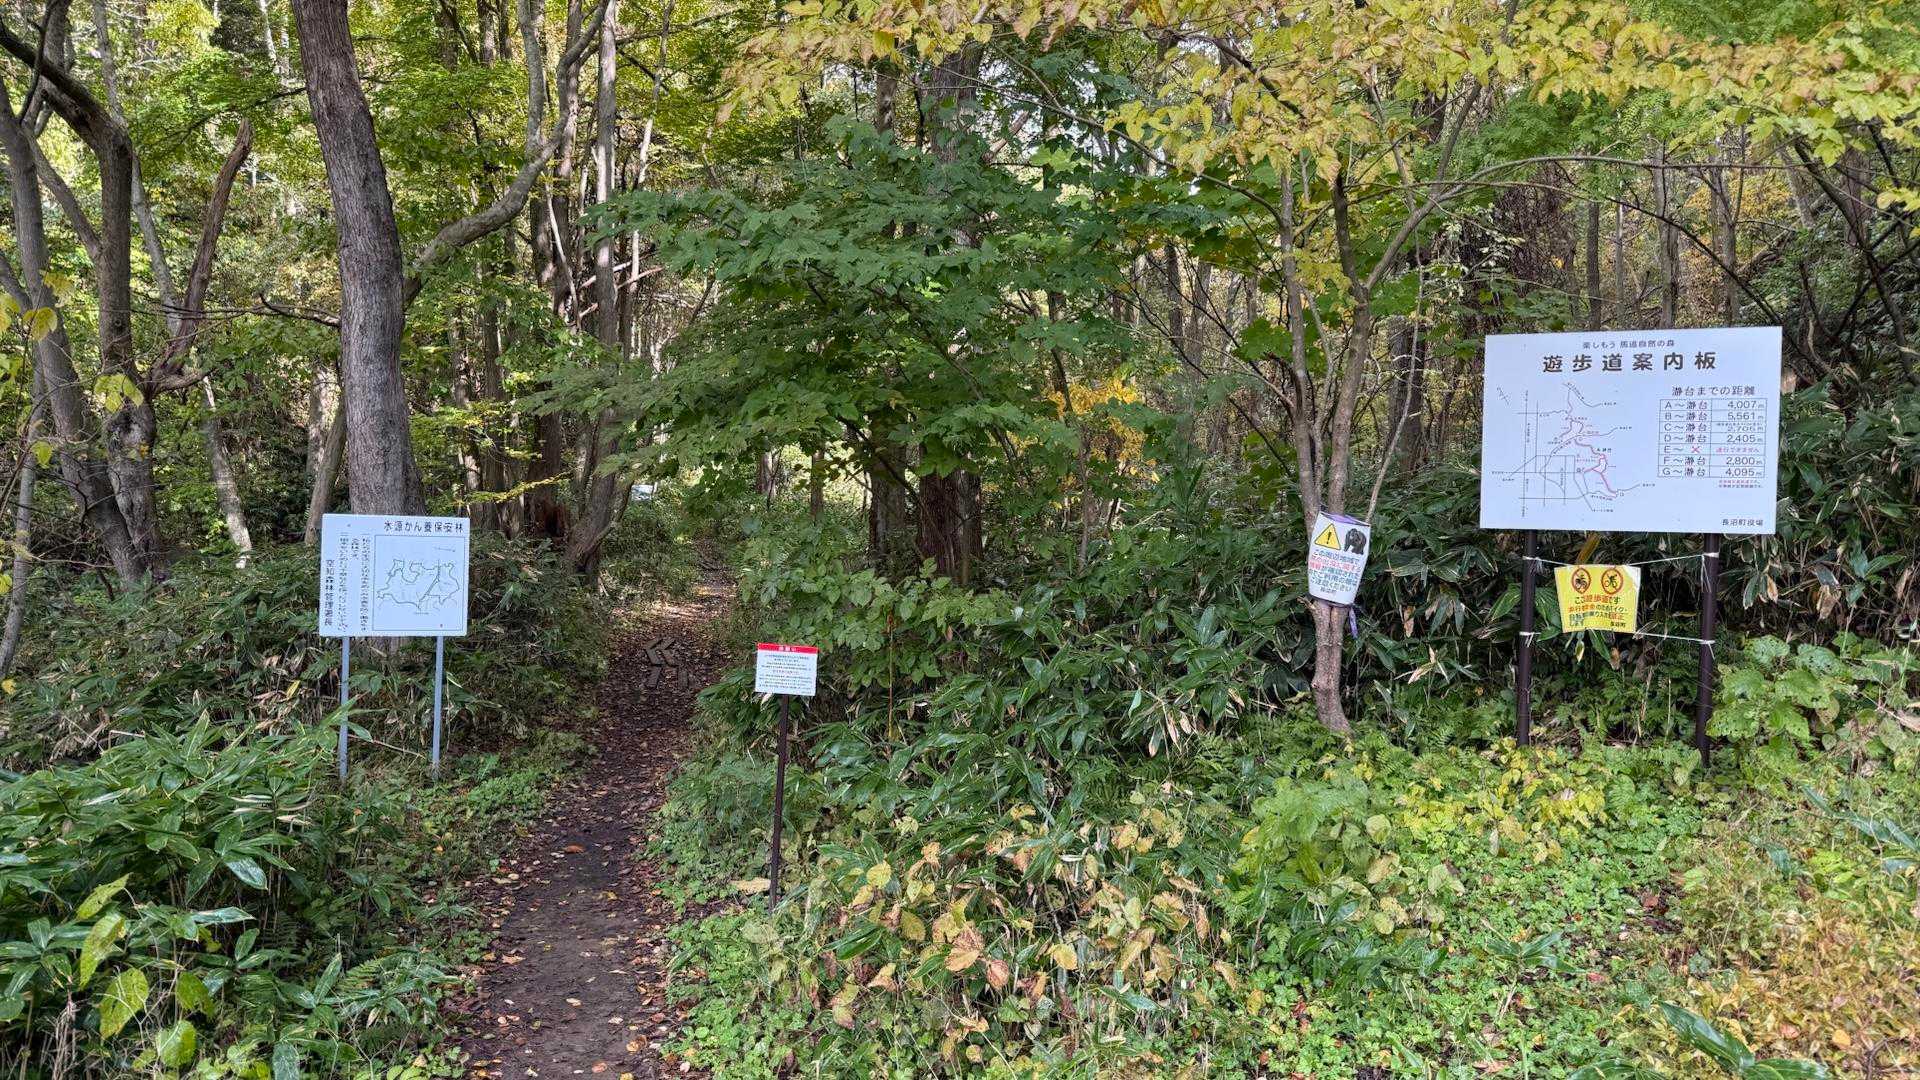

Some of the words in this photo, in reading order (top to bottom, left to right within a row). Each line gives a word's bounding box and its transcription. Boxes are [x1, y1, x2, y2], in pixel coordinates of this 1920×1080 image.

[1542, 352, 1717, 373] 遊歩道案内板
[384, 520, 463, 533] 水源かん養保安林
